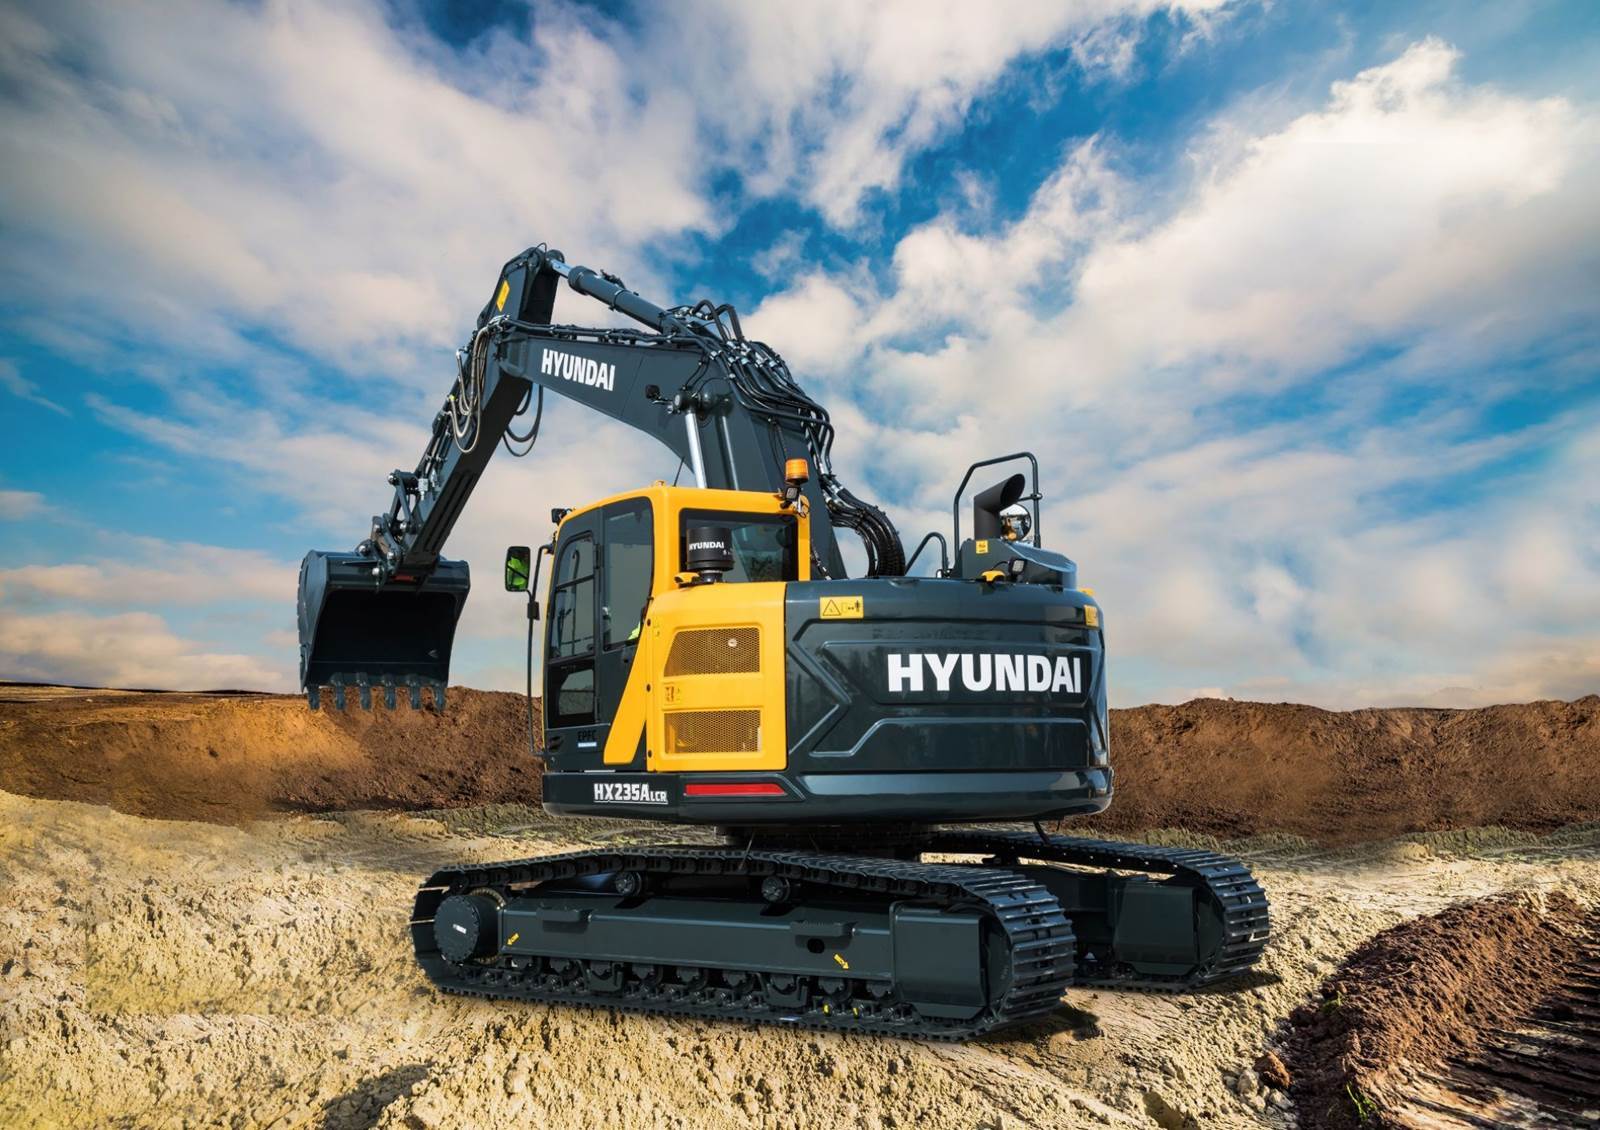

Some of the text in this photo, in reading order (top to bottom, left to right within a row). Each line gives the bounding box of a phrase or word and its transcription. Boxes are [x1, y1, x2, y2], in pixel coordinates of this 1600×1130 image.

[541, 348, 616, 391] HYUNDAI
[689, 541, 725, 551] HYUNDAI
[887, 653, 1081, 693] HYUNDAI
